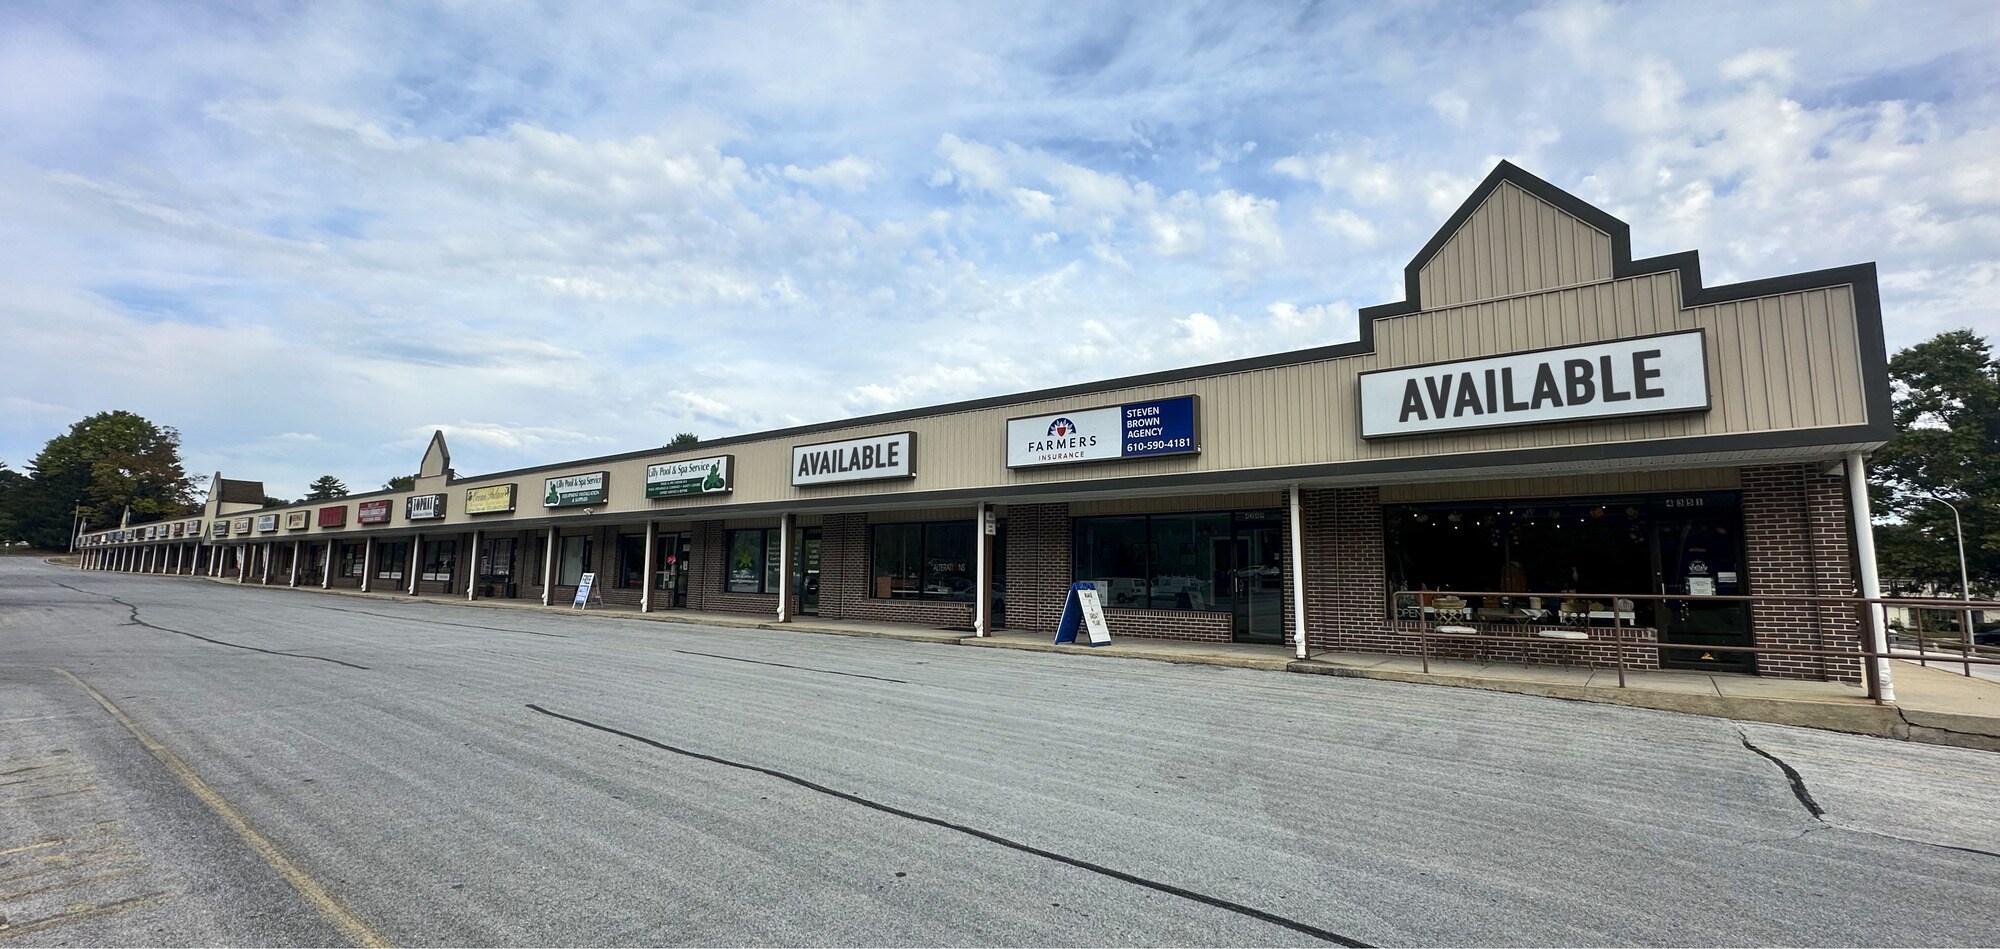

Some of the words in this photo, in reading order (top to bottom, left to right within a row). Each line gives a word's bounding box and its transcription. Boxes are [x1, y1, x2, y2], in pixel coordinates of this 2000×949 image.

[1399, 349, 1665, 423] AVAILABLE
[1126, 406, 1160, 418] STEVEN
[1126, 417, 1160, 428] BROWN
[1127, 427, 1163, 439] AGENCY
[1028, 435, 1097, 453] FARMERS
[1127, 438, 1191, 452] 610-590-4181
[798, 441, 900, 477] AVAILABLE
[1038, 451, 1085, 461] INSURANCE
[659, 465, 671, 476] Pool
[672, 465, 677, 475] &
[678, 464, 688, 476] Spa
[689, 461, 710, 473] Service
[564, 478, 573, 487] Pool
[574, 478, 578, 486] &
[579, 477, 587, 488] Spa
[586, 474, 602, 485] Service
[1666, 498, 1704, 507] 4351
